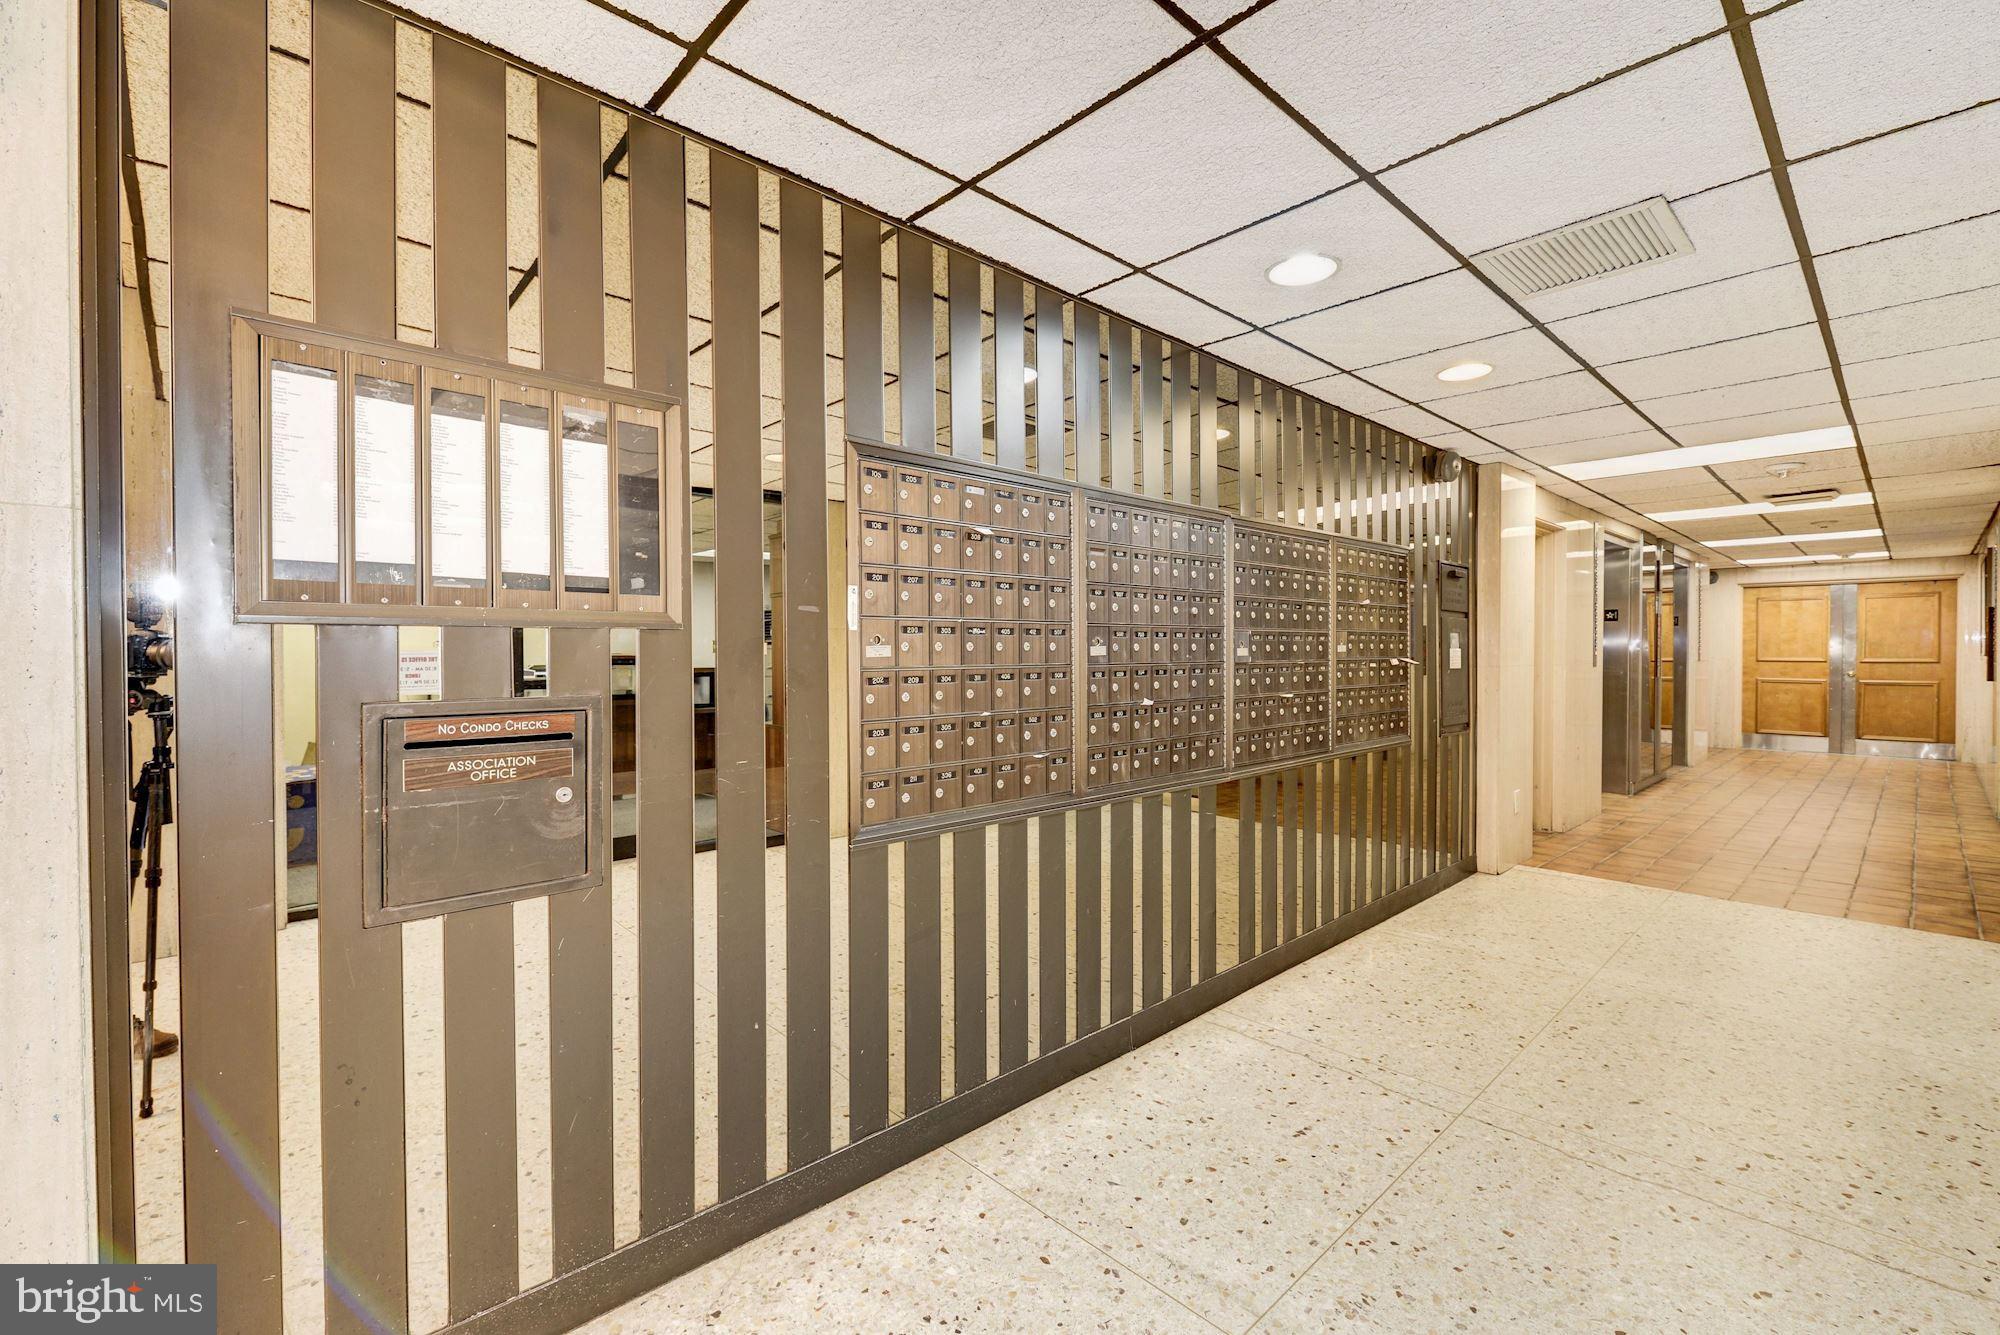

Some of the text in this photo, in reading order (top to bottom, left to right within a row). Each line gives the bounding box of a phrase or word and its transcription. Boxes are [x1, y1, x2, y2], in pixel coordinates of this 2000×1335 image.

[872, 677, 884, 685] 202
[908, 676, 920, 684] 209
[872, 729, 884, 737] 203
[447, 755, 537, 772] ASSOCIATION
[470, 768, 517, 782] OFFICE
